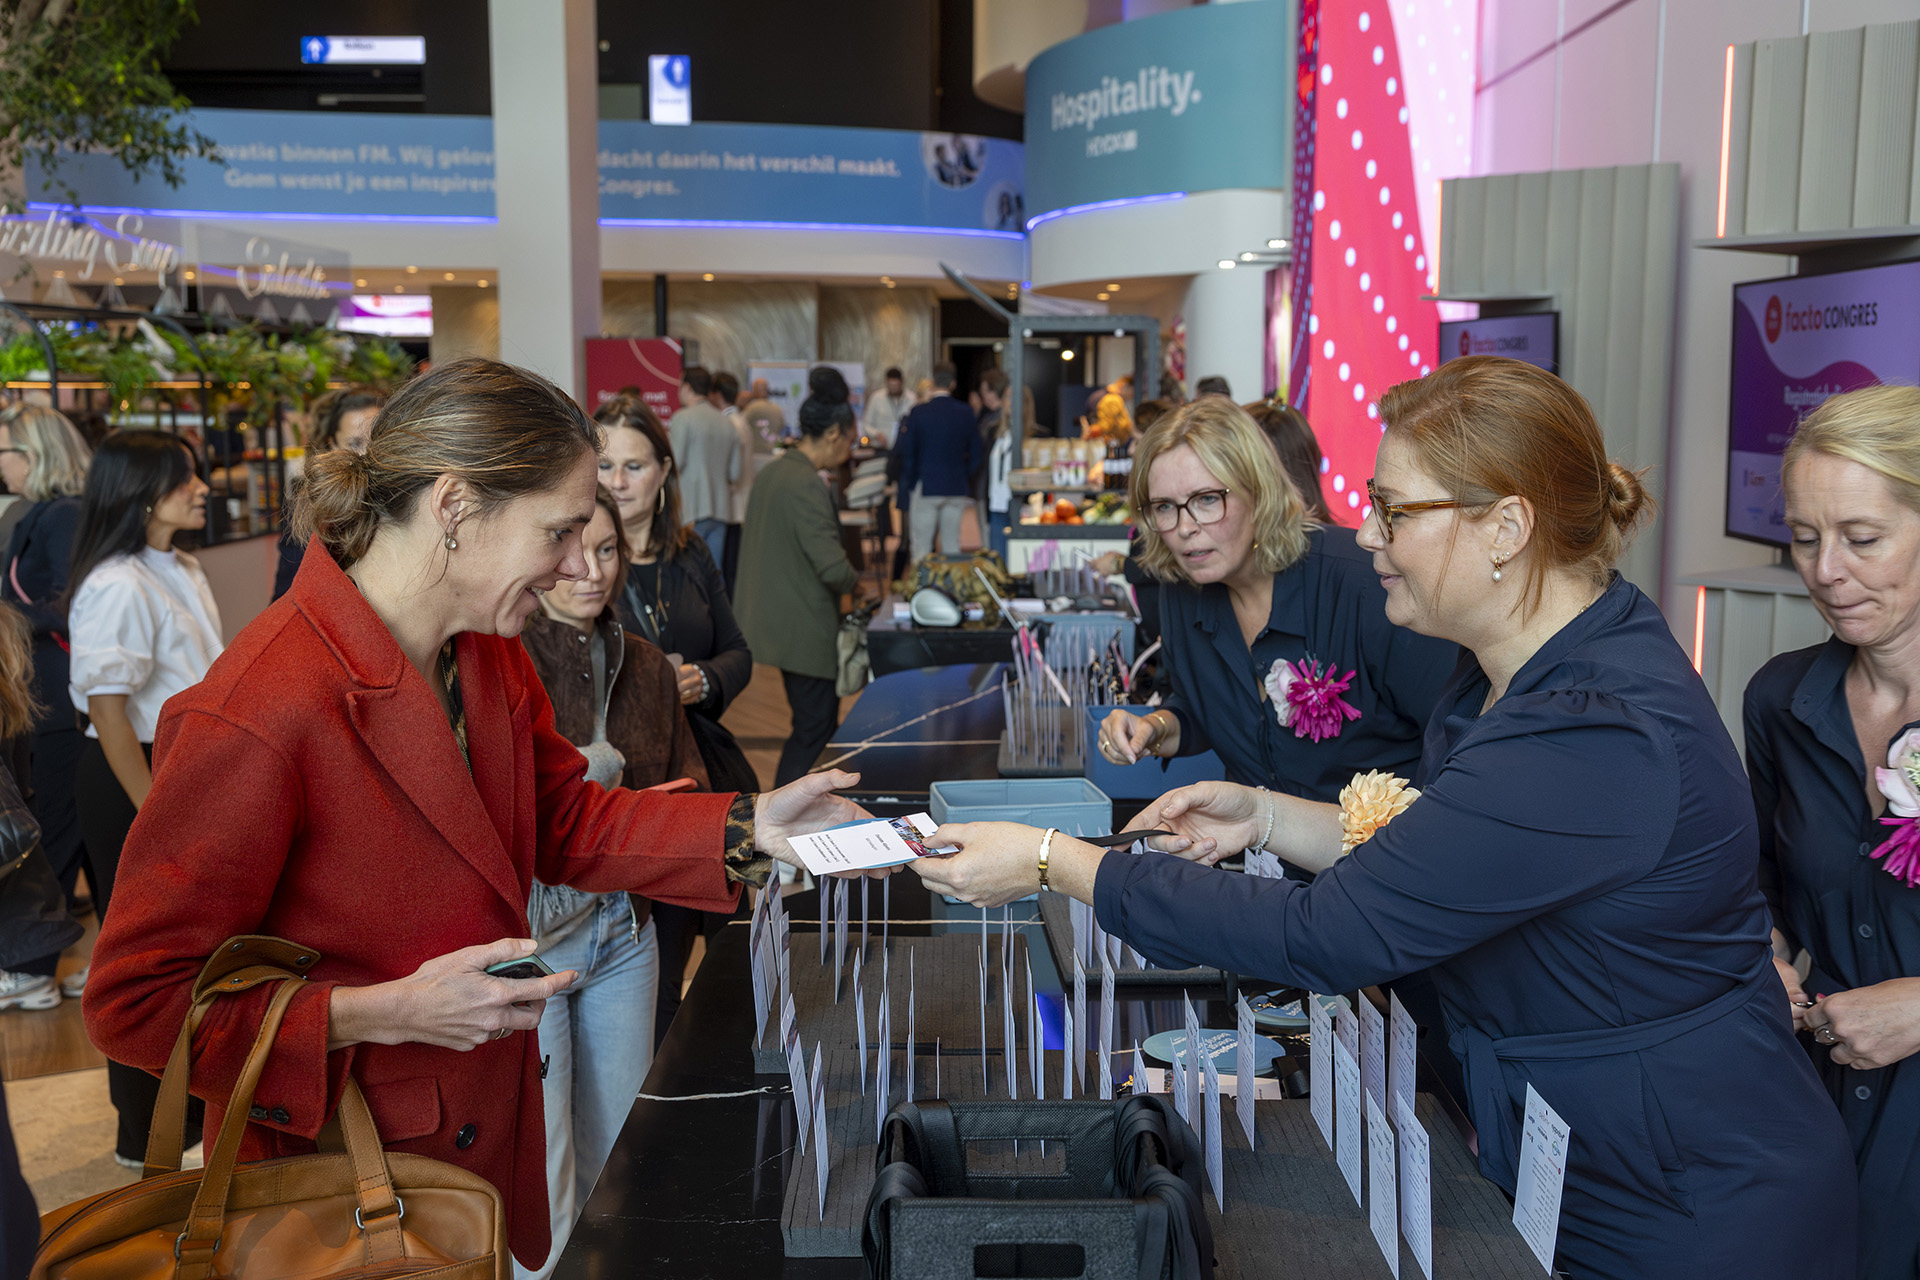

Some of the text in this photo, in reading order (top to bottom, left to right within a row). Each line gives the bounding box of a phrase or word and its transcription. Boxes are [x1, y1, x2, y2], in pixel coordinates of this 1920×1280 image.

[1051, 65, 1202, 132] Hospitality.
[280, 142, 354, 162] binnen
[359, 144, 397, 165] FM.
[399, 144, 434, 170] Wij
[657, 150, 719, 170] daarin
[722, 151, 756, 171] het
[759, 155, 835, 175] verschil
[838, 156, 901, 178] maakt.
[224, 167, 276, 188] Gom
[279, 172, 343, 191] wenst
[345, 171, 366, 194] je
[369, 174, 408, 192] een
